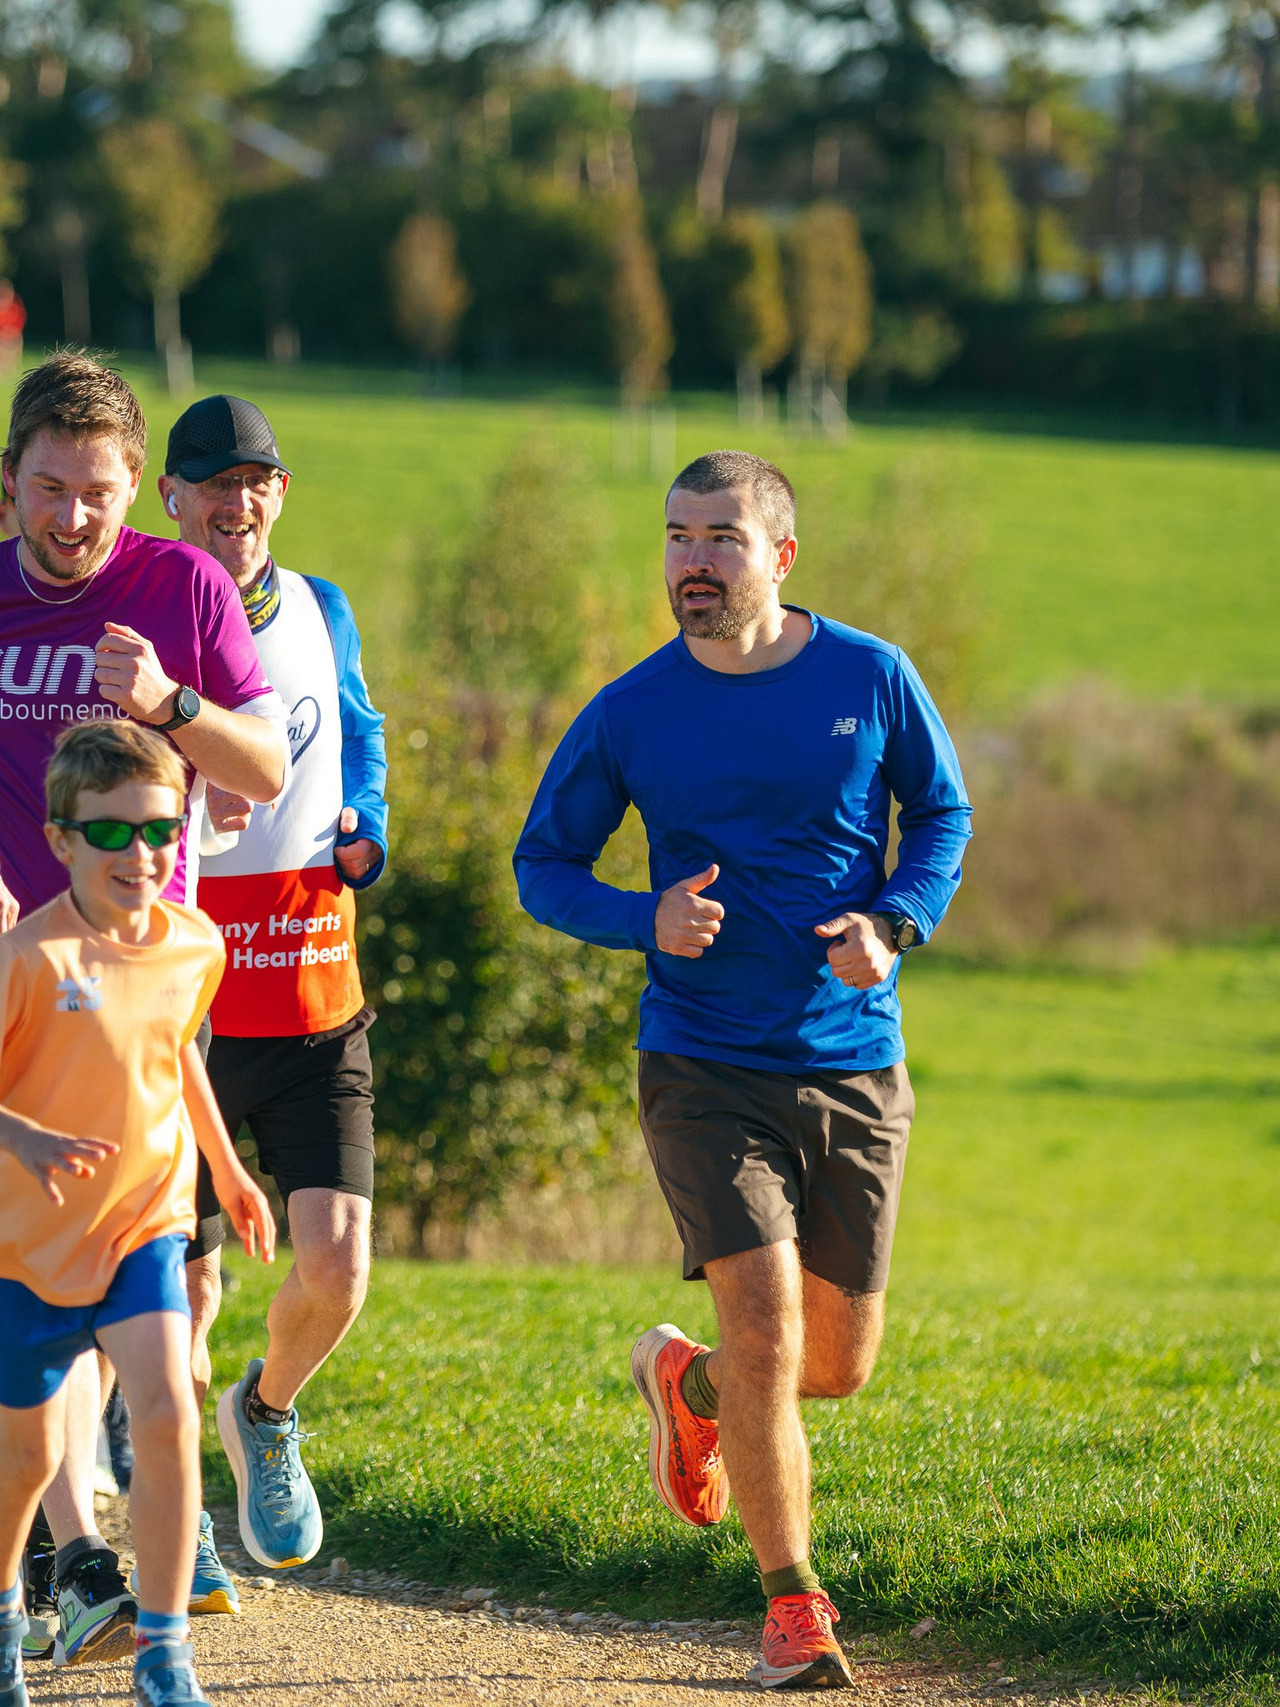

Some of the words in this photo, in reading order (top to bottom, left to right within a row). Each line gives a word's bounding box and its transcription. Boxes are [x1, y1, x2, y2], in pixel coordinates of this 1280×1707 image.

[216, 922, 261, 944] ny
[268, 911, 341, 936] Hearts
[233, 941, 349, 969] Heartbeat
[670, 1414, 686, 1477] balance
